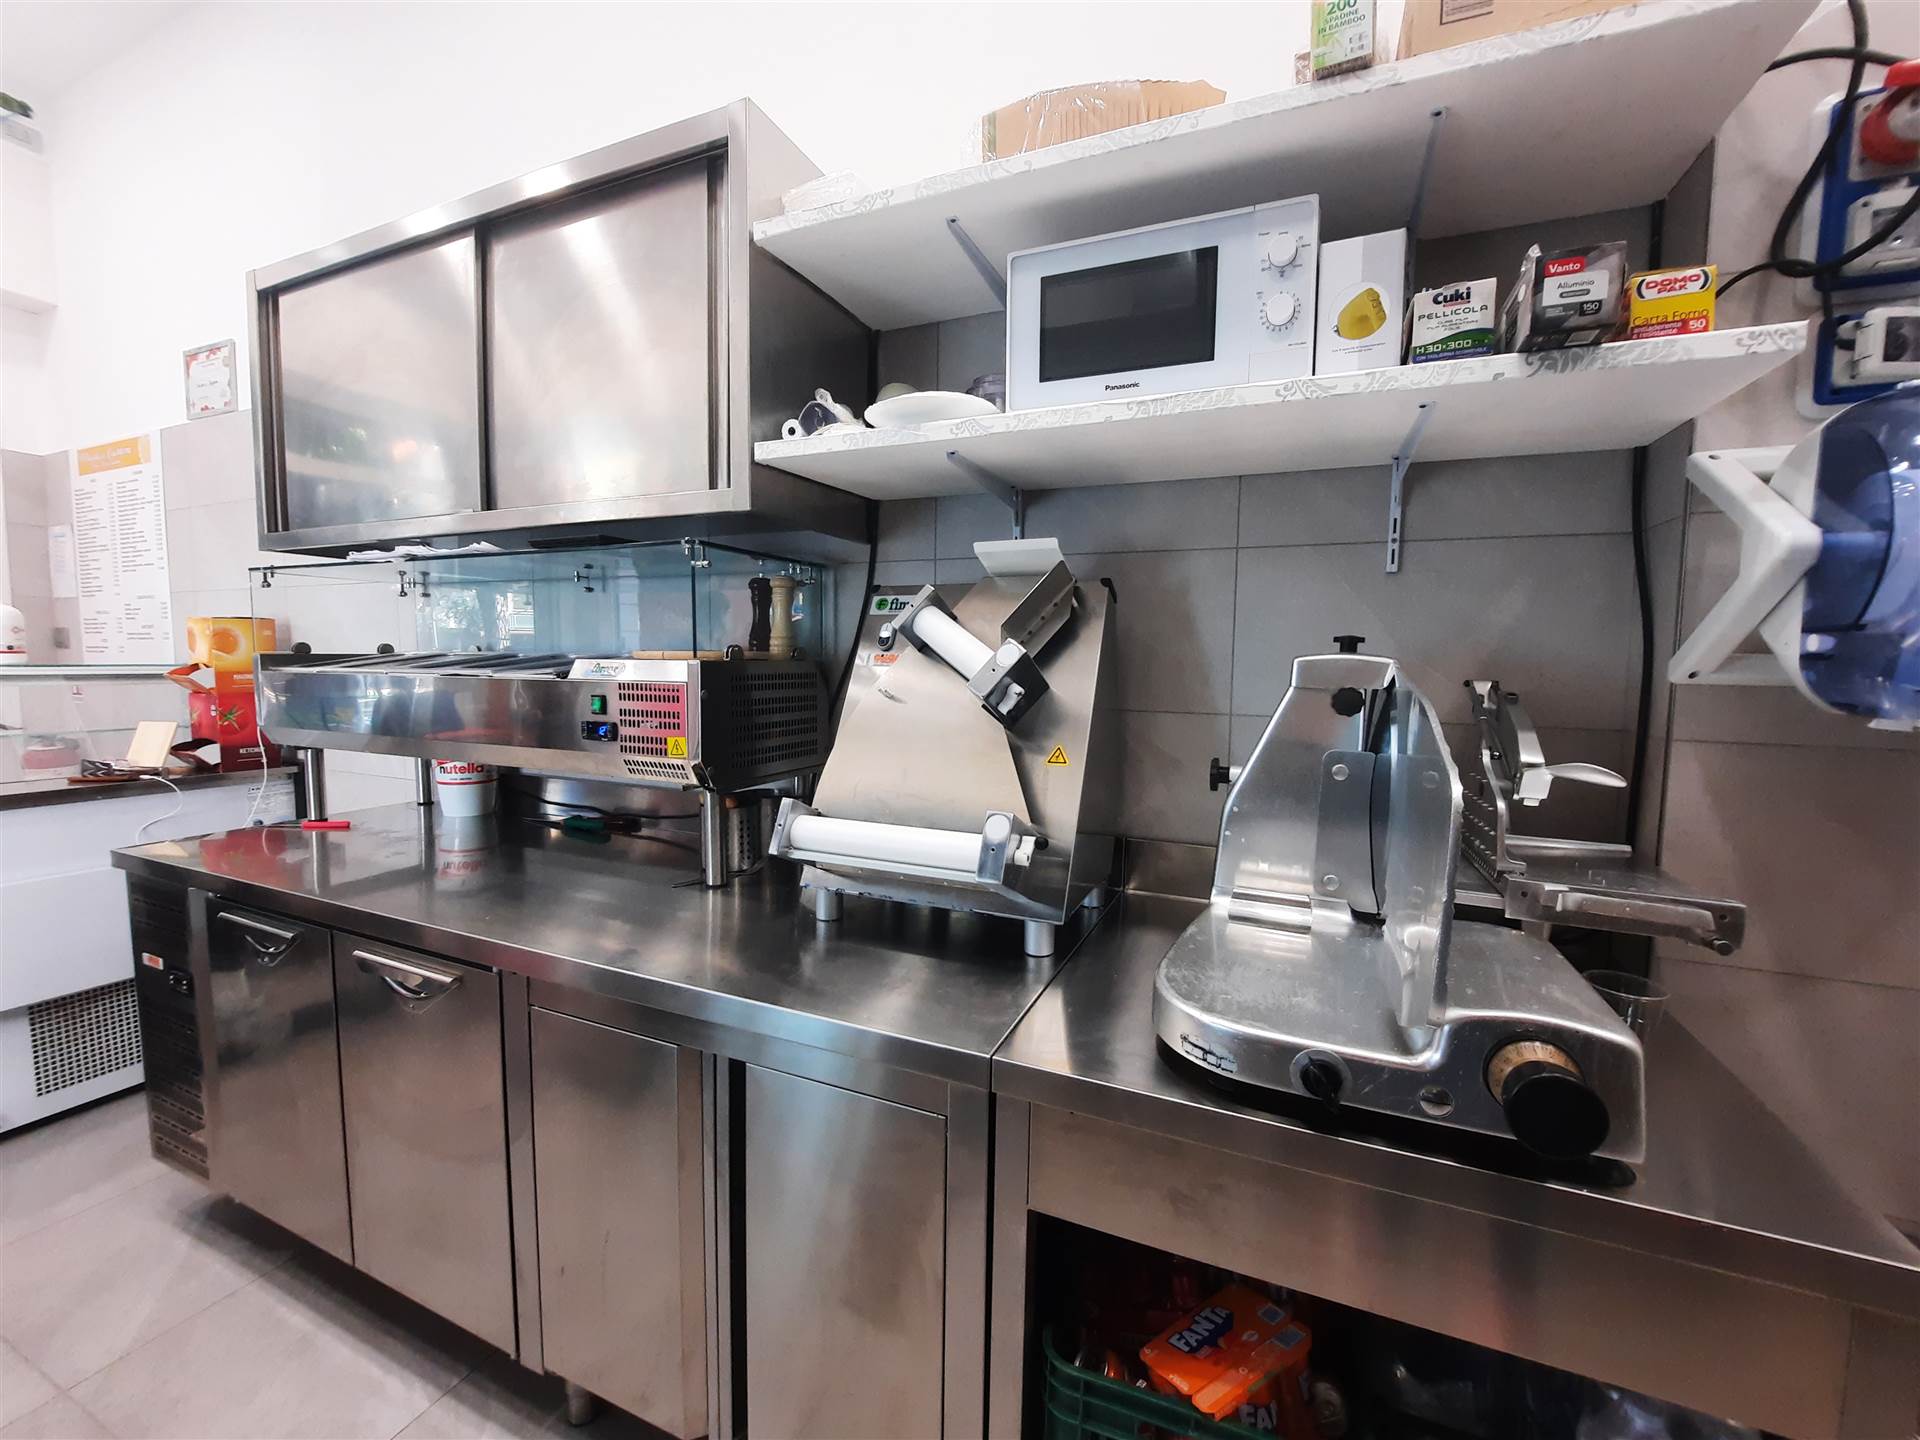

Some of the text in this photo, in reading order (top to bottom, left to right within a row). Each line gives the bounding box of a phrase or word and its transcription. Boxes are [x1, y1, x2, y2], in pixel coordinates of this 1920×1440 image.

[1327, 0, 1358, 16] 200
[1318, 27, 1327, 35] IN
[1329, 14, 1366, 32] BAMBOO
[1549, 263, 1581, 273] Vanto
[1557, 280, 1595, 289] Alluminio
[1645, 274, 1702, 290] DOMO
[1657, 283, 1688, 294] PAK
[1432, 286, 1472, 305] Cuki
[1418, 304, 1488, 322] PELLICOLA
[1583, 302, 1600, 311] 150
[1633, 308, 1709, 327] Carta Forno
[1689, 318, 1706, 330] 50
[1104, 381, 1140, 391] Panasonic
[439, 762, 484, 774] nutella
[1168, 1306, 1232, 1352] FANTA
